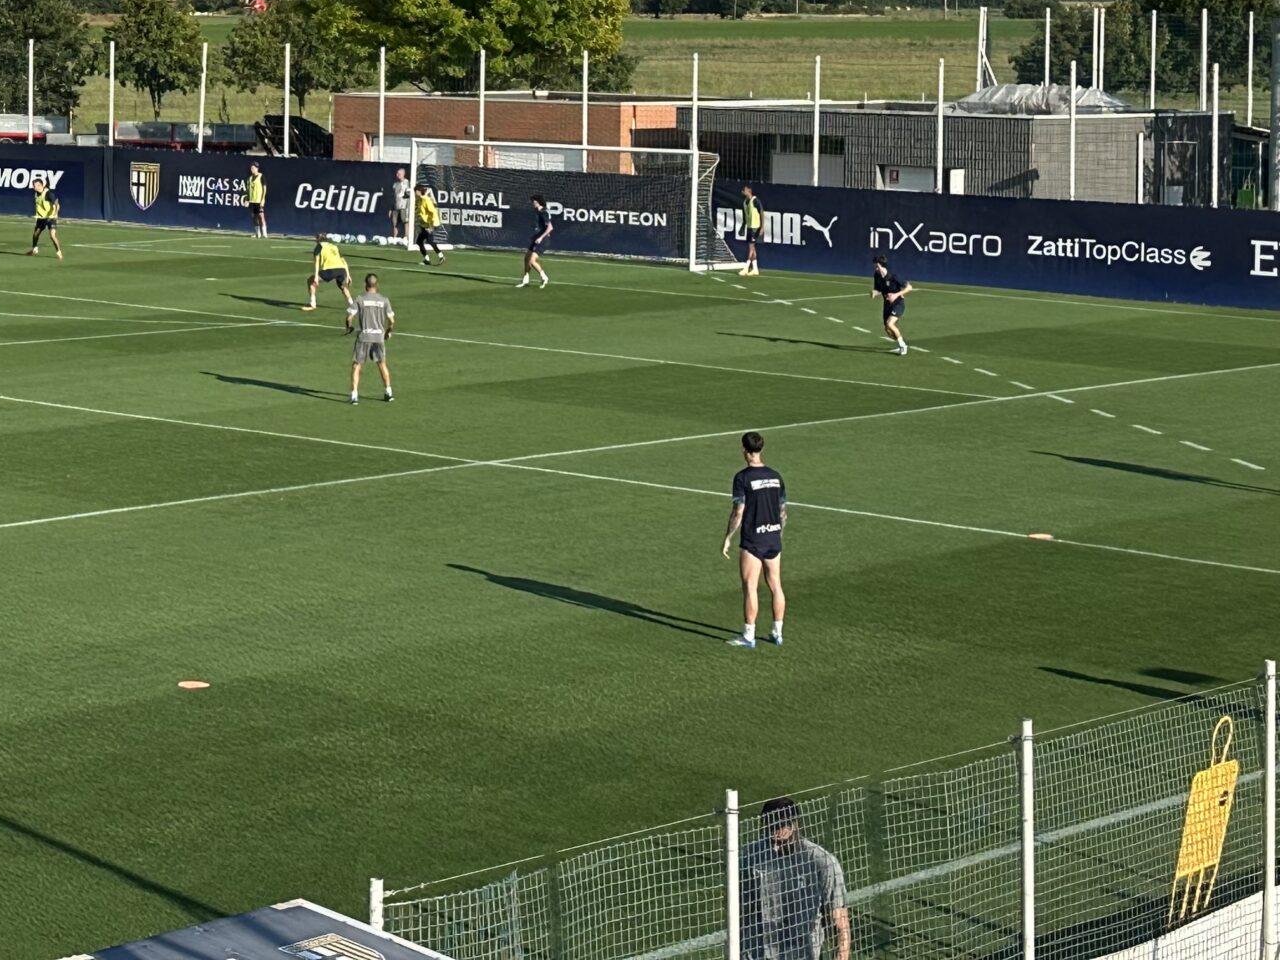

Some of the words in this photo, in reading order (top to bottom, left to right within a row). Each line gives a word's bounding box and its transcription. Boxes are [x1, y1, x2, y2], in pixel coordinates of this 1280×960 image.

[206, 177, 230, 191] GAS
[295, 183, 383, 213] Cetilar
[546, 202, 667, 227] PROMETEON
[716, 207, 801, 246] PUMA
[1027, 235, 1186, 265] ZattiTopClass
